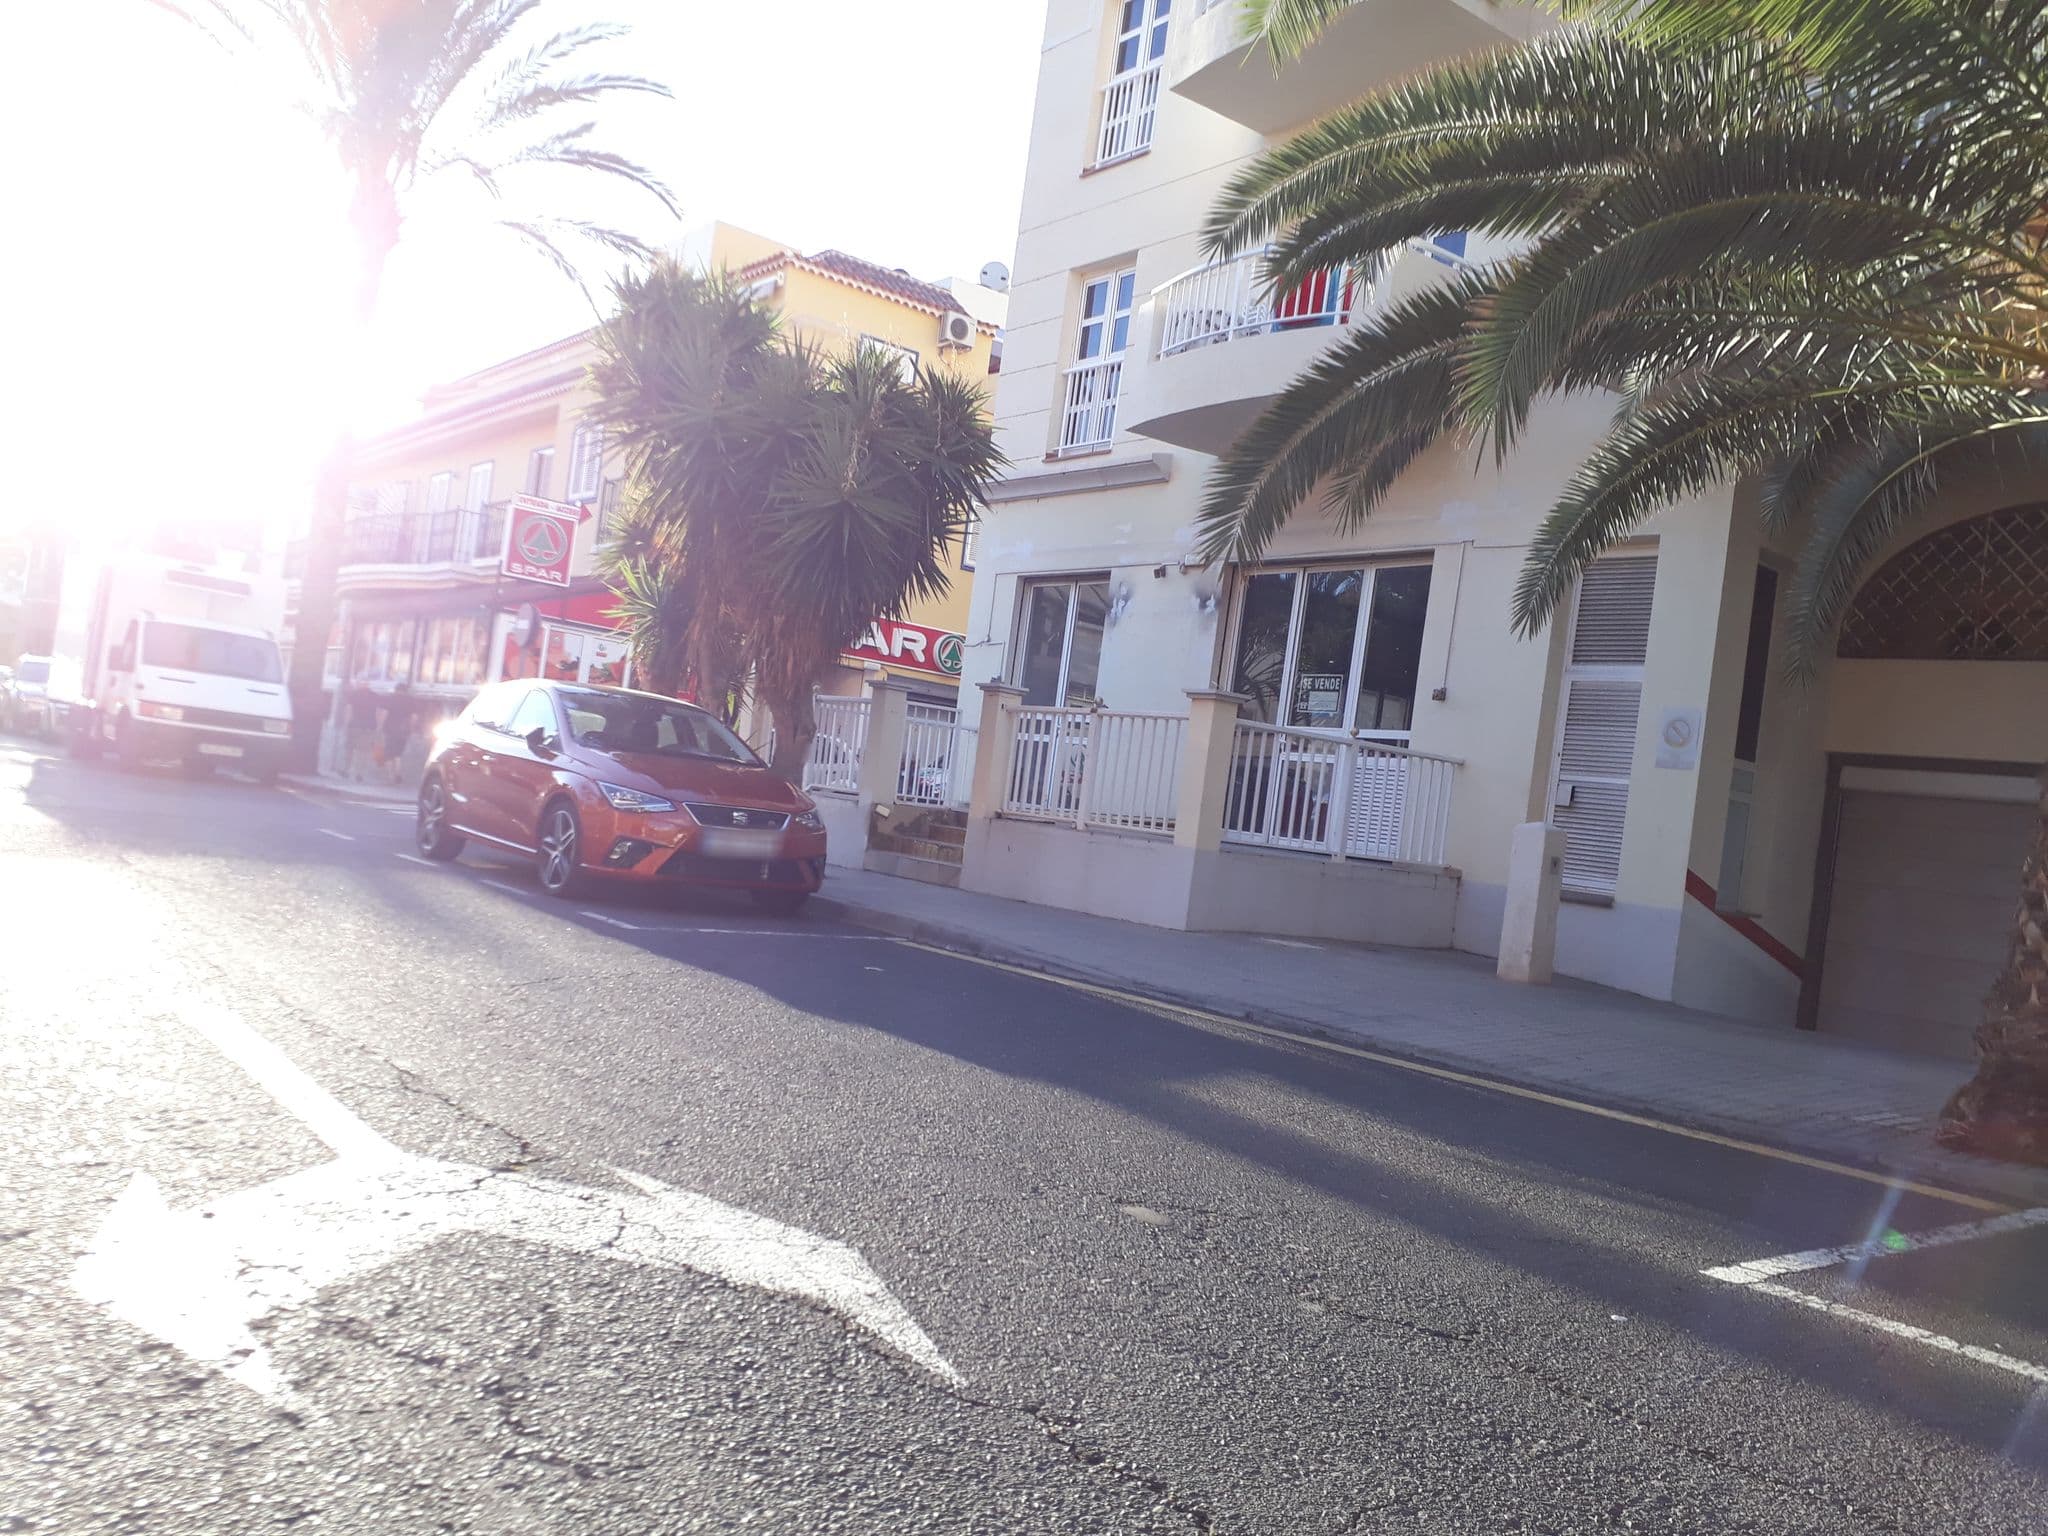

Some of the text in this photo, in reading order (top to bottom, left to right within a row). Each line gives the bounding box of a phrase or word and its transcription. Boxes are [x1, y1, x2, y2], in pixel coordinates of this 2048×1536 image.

[509, 562, 563, 582] SPAR
[850, 621, 927, 663] AR
[1303, 677, 1341, 690] SE VENDE
